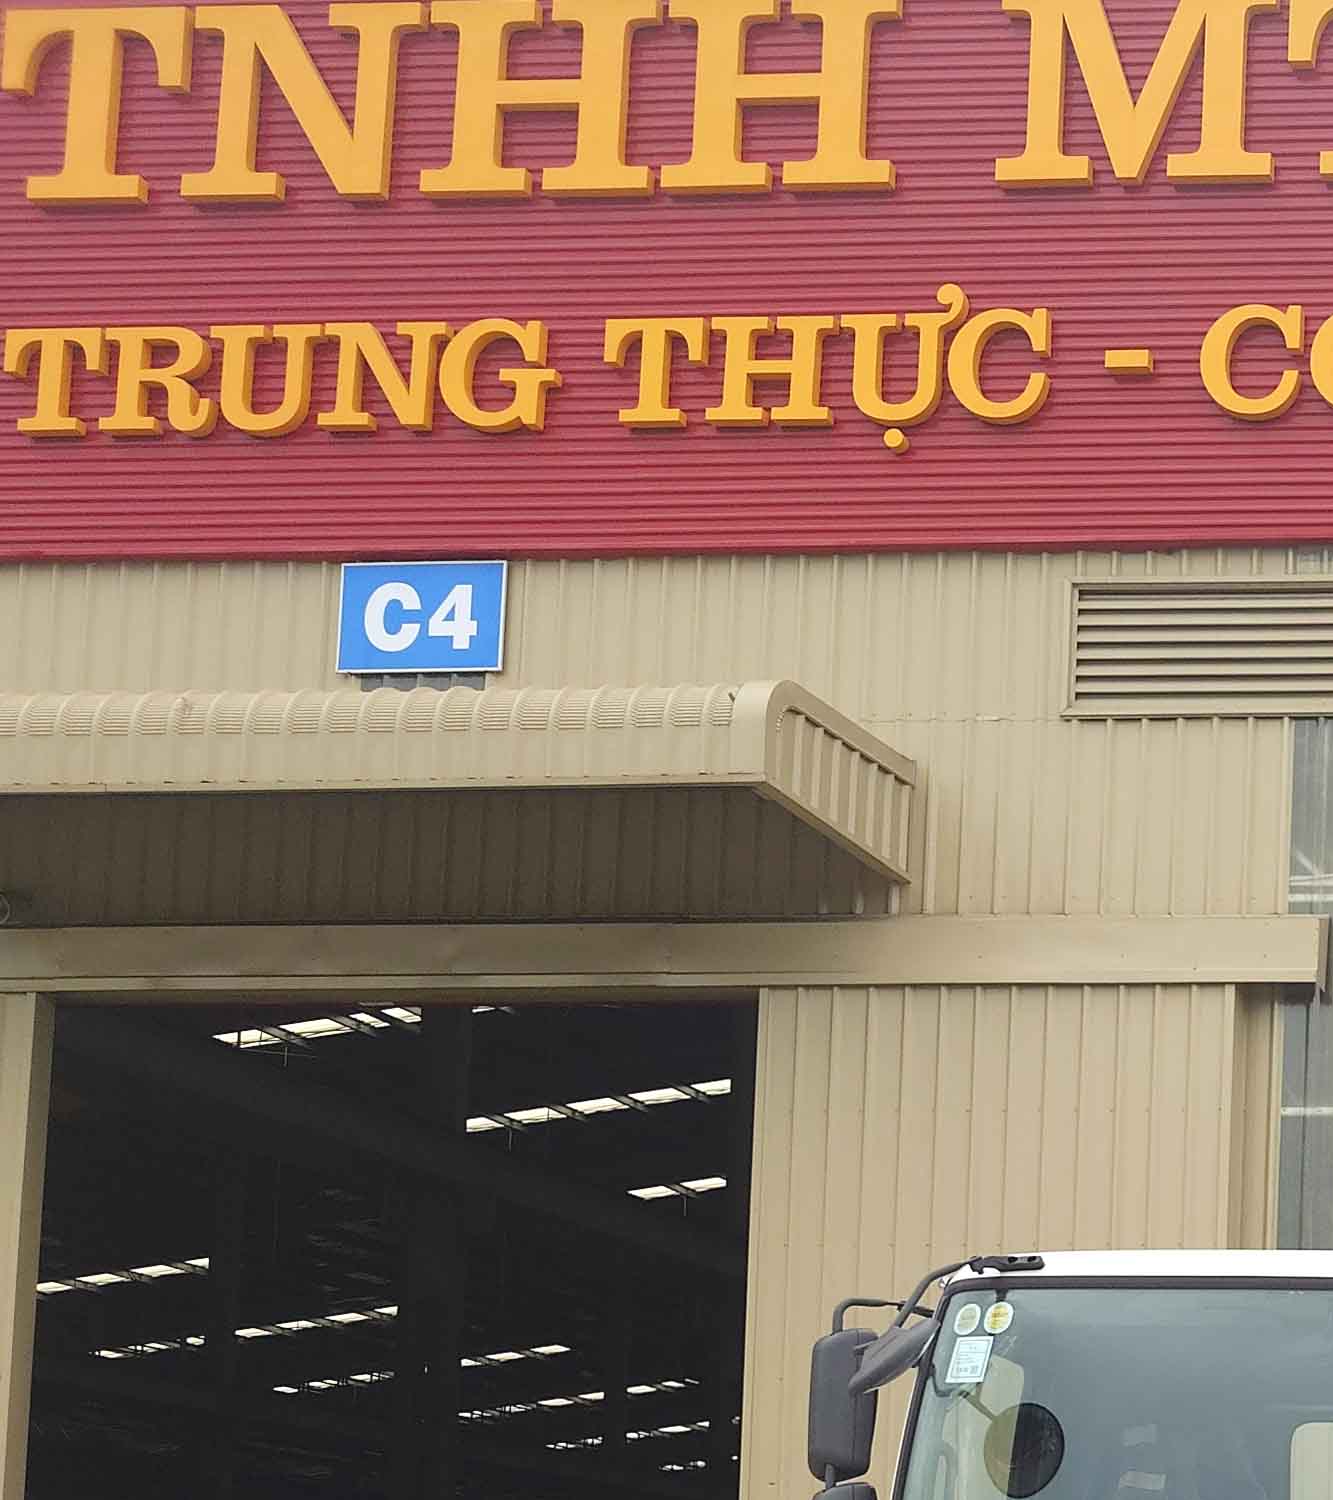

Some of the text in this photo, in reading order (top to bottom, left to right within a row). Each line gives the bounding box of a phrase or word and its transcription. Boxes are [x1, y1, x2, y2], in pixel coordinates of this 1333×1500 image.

[1, 0, 903, 203] TNHH
[2, 317, 563, 438] TRUNG
[603, 283, 1053, 454] THỰC
[364, 581, 478, 652] C4
